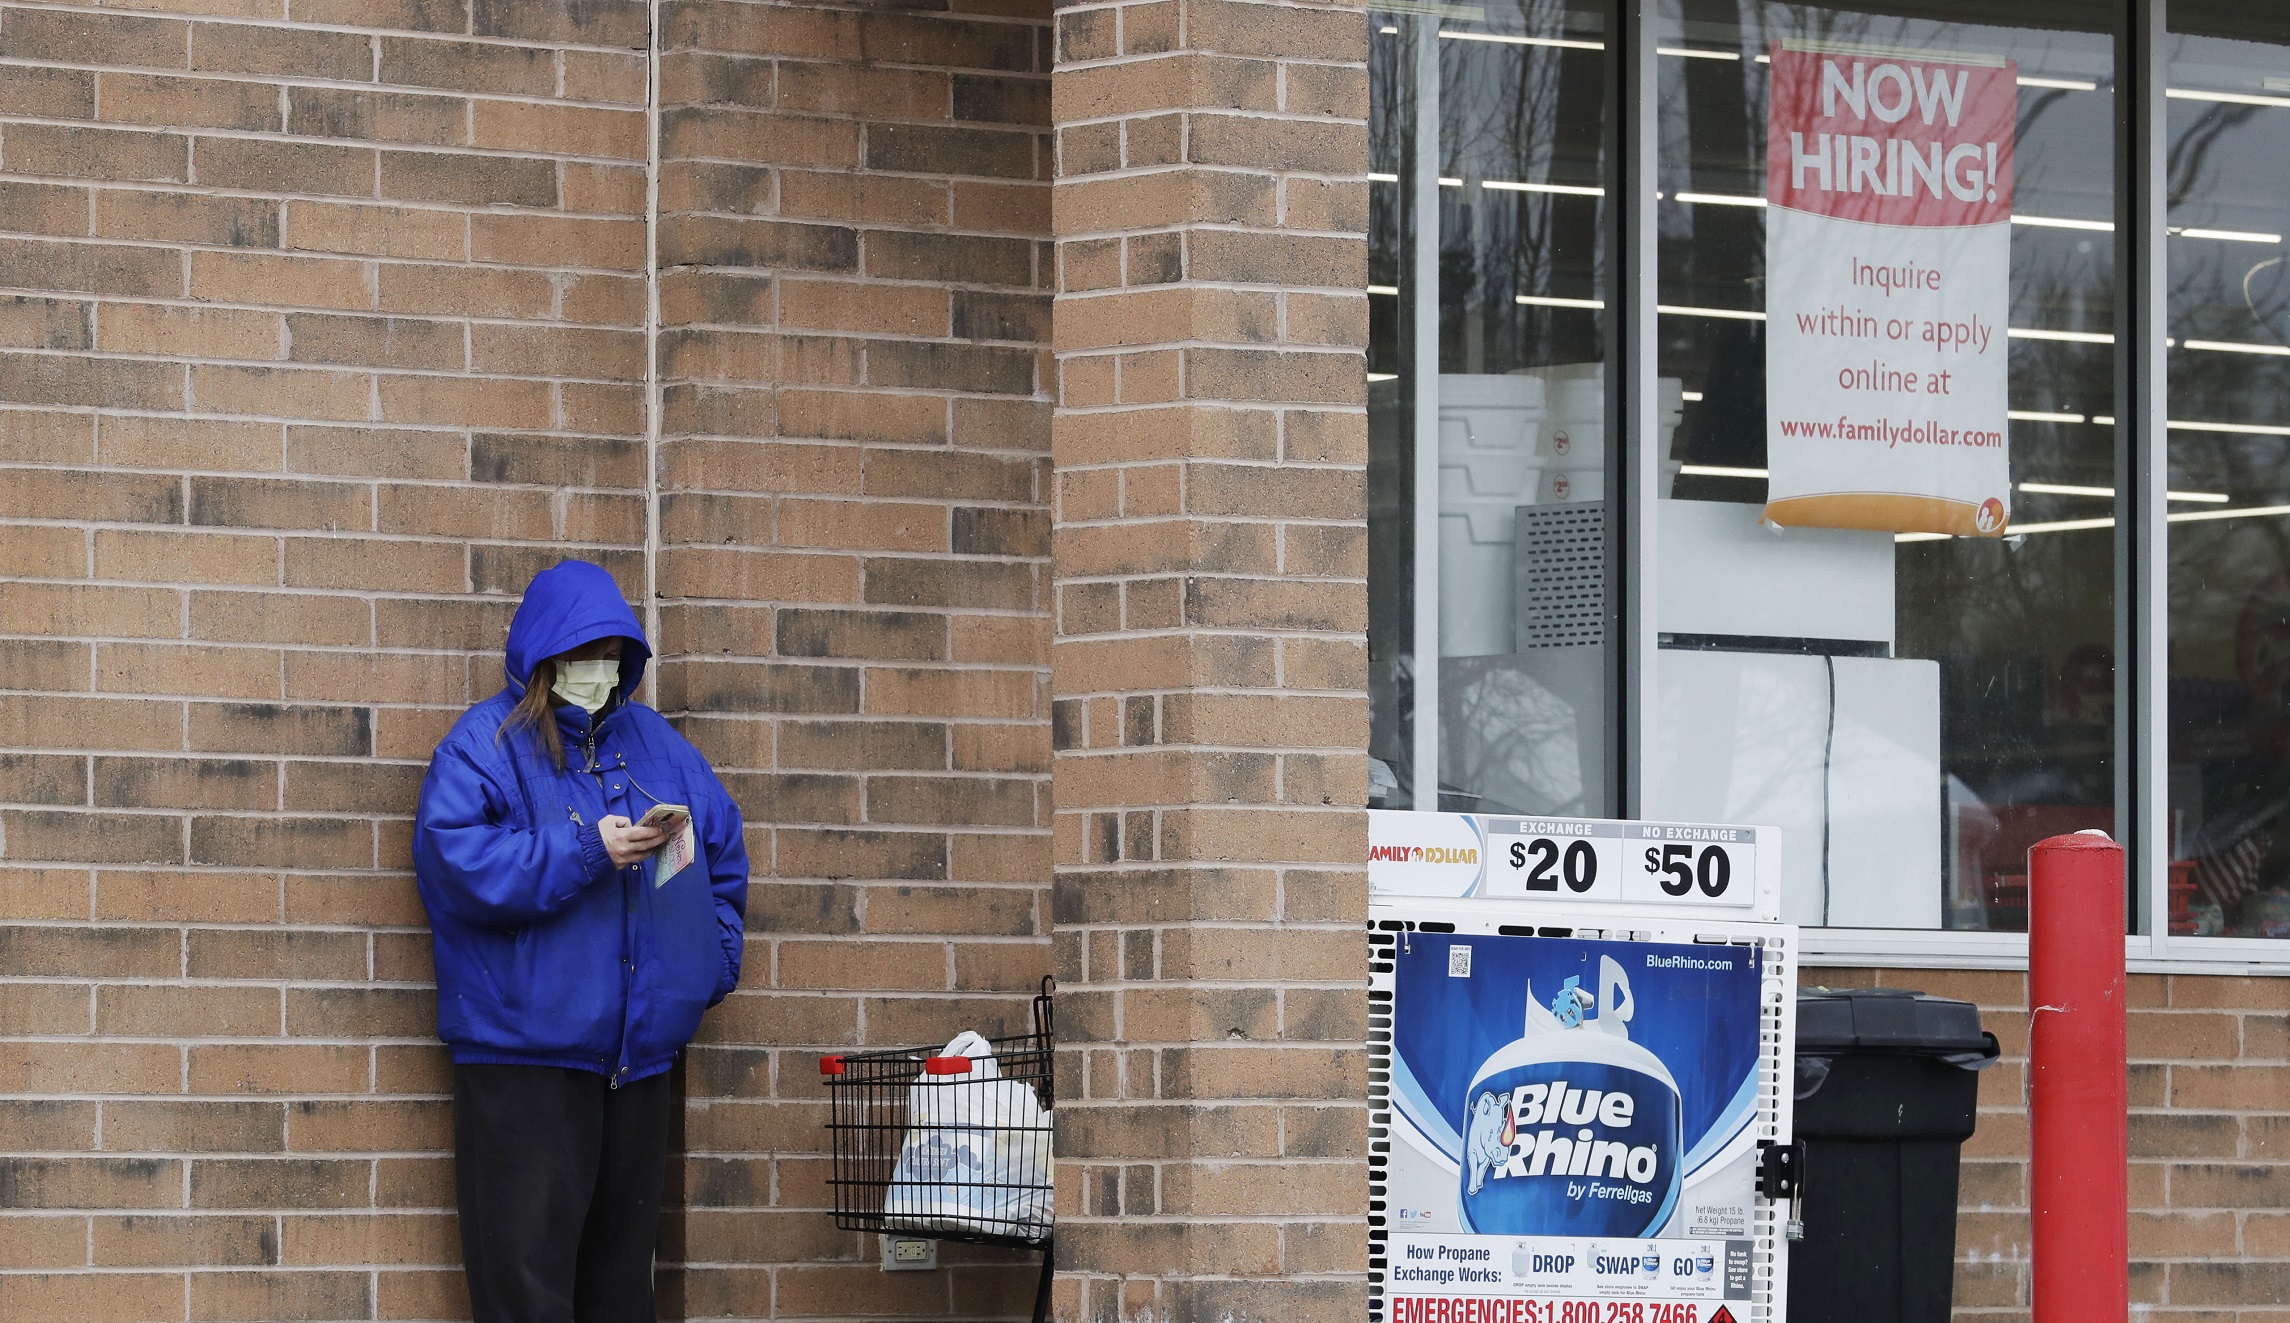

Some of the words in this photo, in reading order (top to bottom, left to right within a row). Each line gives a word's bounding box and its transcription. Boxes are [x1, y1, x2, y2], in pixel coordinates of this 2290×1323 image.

[1823, 60, 1968, 127] NOW
[1791, 132, 1997, 204] HIRING!
[1853, 257, 1941, 297] Inquire
[1796, 305, 1877, 338] within
[1886, 319, 1913, 340] or
[1922, 313, 1991, 354] apply
[1839, 359, 1918, 393] online
[1926, 369, 1951, 395] at
[1780, 416, 2002, 449] www.familydollar.com
[1519, 821, 1593, 836] EXCHANGE
[1642, 827, 1661, 838] NO
[1666, 827, 1737, 841] EXCHANGE
[1369, 845, 1412, 862] AMILY
[1425, 847, 1478, 864] DOLLAR
[1509, 838, 1597, 893] $20
[1644, 844, 1731, 897] $50
[1646, 954, 1733, 971] BlueRhino.com
[1511, 1081, 1634, 1128] Blue
[1493, 1128, 1657, 1184] Rhino
[1567, 1181, 1585, 1200] by
[1588, 1182, 1653, 1204] Ferrellgas
[1695, 1206, 1705, 1214] Net
[1707, 1206, 1727, 1216] Weight
[1729, 1207, 1736, 1215] 15
[1720, 1216, 1744, 1226] Propane
[1407, 1244, 1434, 1260] How
[1438, 1245, 1490, 1263] Propane
[1532, 1254, 1575, 1273] DROP
[1394, 1266, 1454, 1285] Exchange
[1458, 1267, 1502, 1283] Works:
[1596, 1256, 1640, 1275] SWAP
[1673, 1257, 1694, 1276] GO
